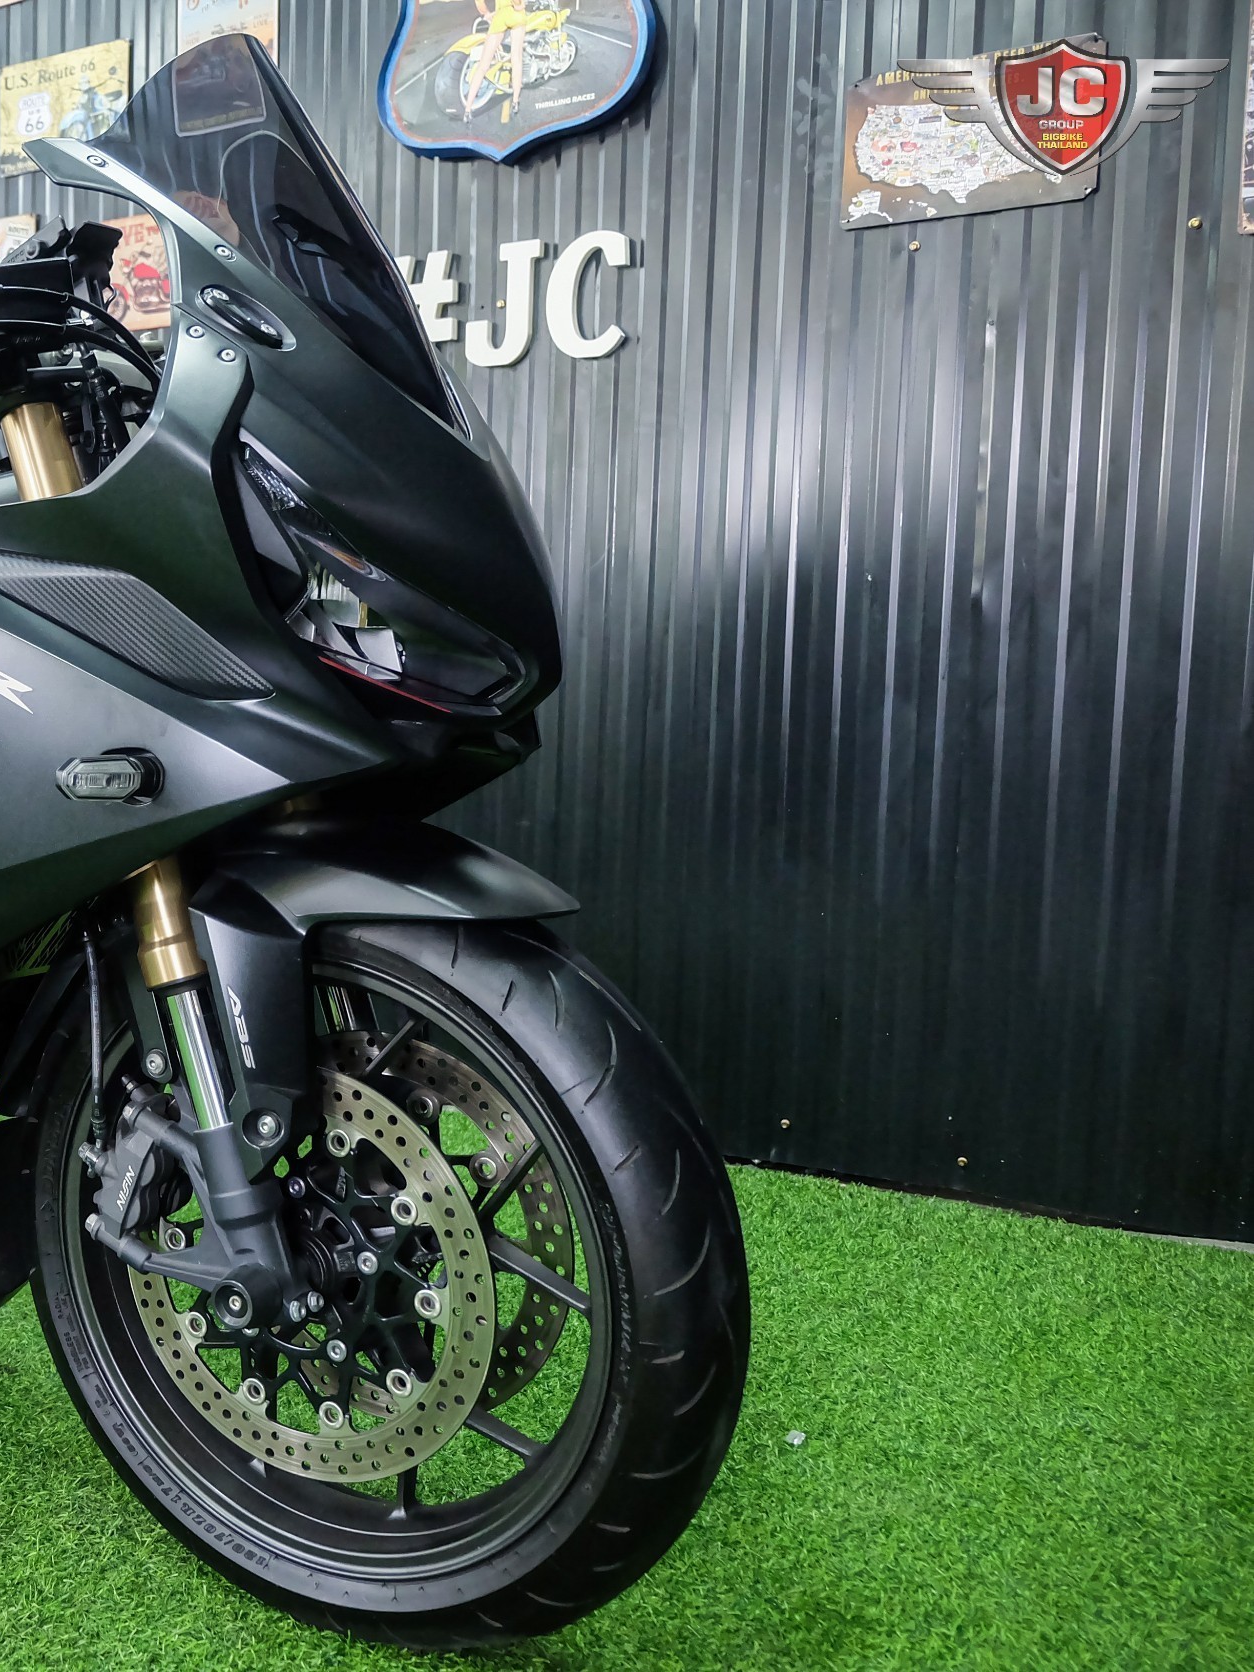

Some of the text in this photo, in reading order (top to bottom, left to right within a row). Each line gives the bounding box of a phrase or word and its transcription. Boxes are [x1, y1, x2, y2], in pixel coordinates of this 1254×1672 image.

[4, 60, 96, 91] U.S. Route 66
[535, 92, 596, 109] THRILLING RACES
[25, 115, 45, 133] 66
[395, 230, 631, 367] #JC
[227, 985, 256, 1070] ABS
